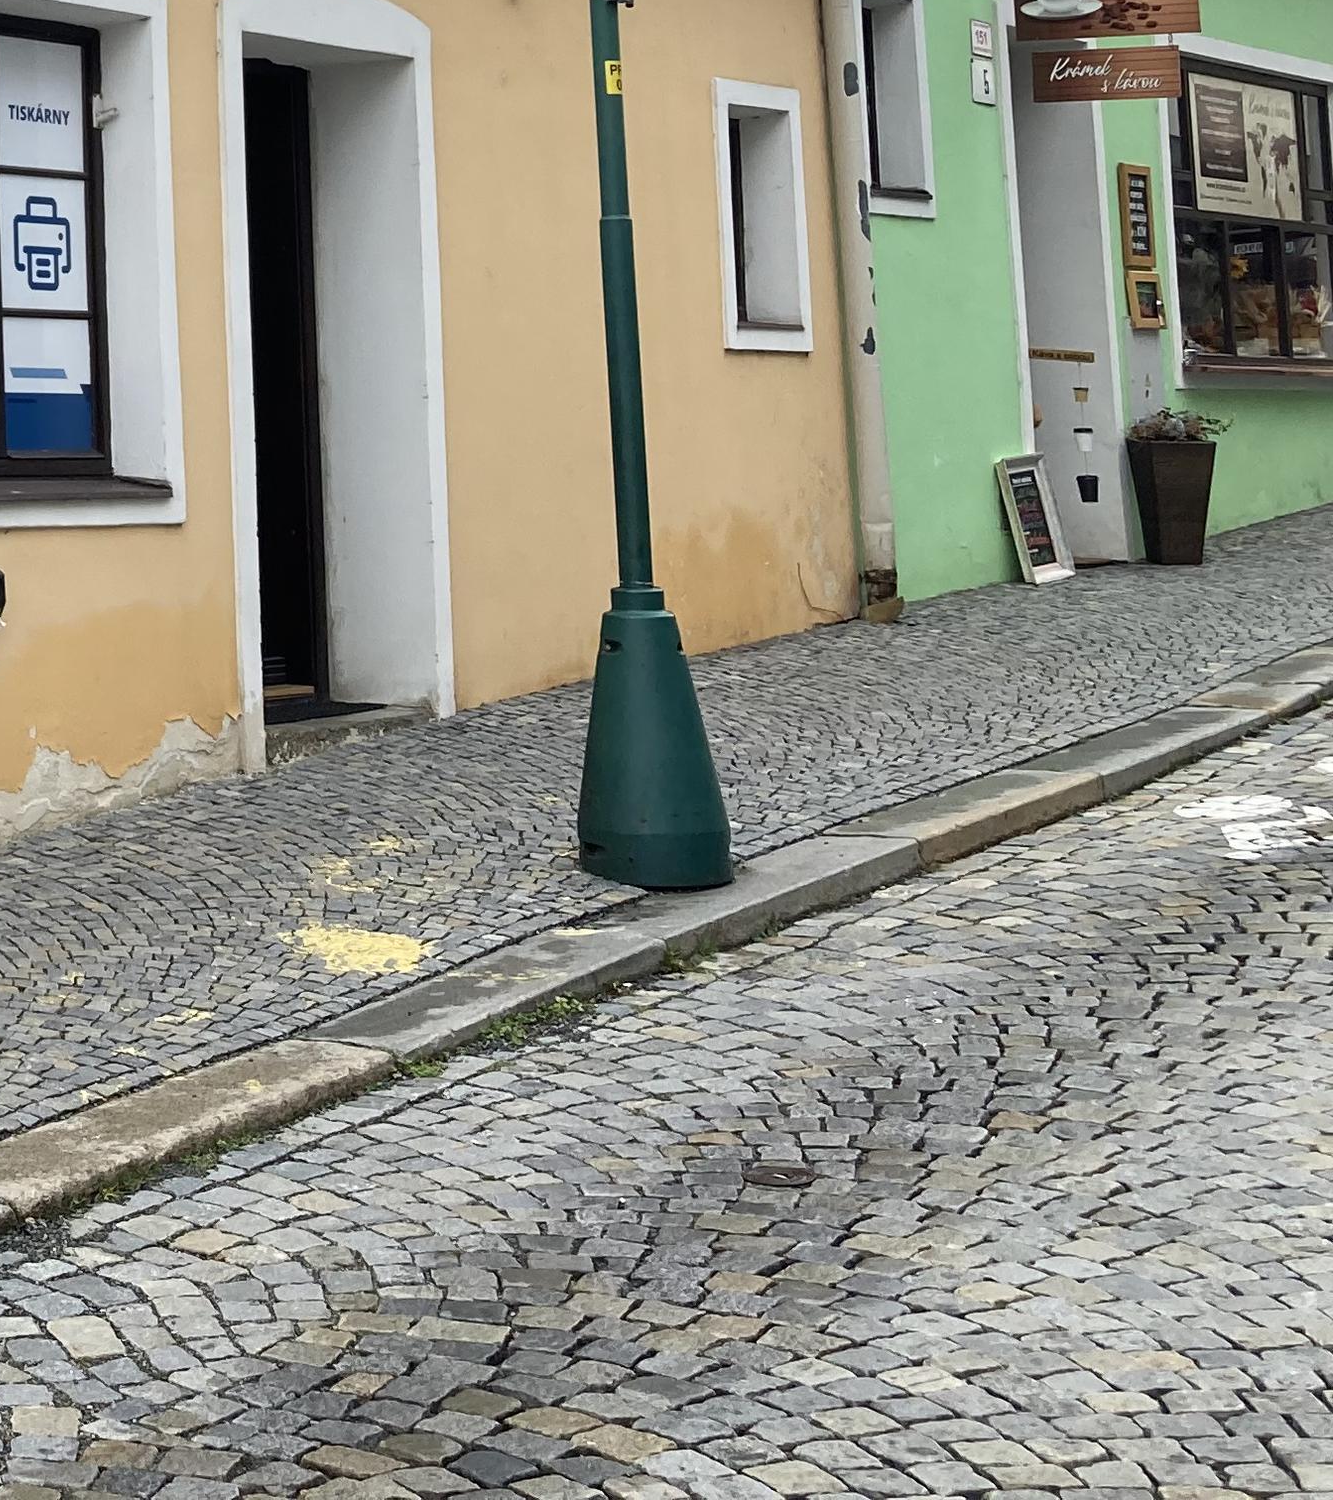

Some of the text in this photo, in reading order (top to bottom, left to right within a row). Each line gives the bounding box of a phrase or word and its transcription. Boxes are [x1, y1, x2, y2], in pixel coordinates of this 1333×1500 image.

[975, 29, 988, 46] 151
[1050, 54, 1113, 82] Krámek
[1100, 68, 1162, 93] s kávou
[8, 103, 70, 126] TISKÁRNY
